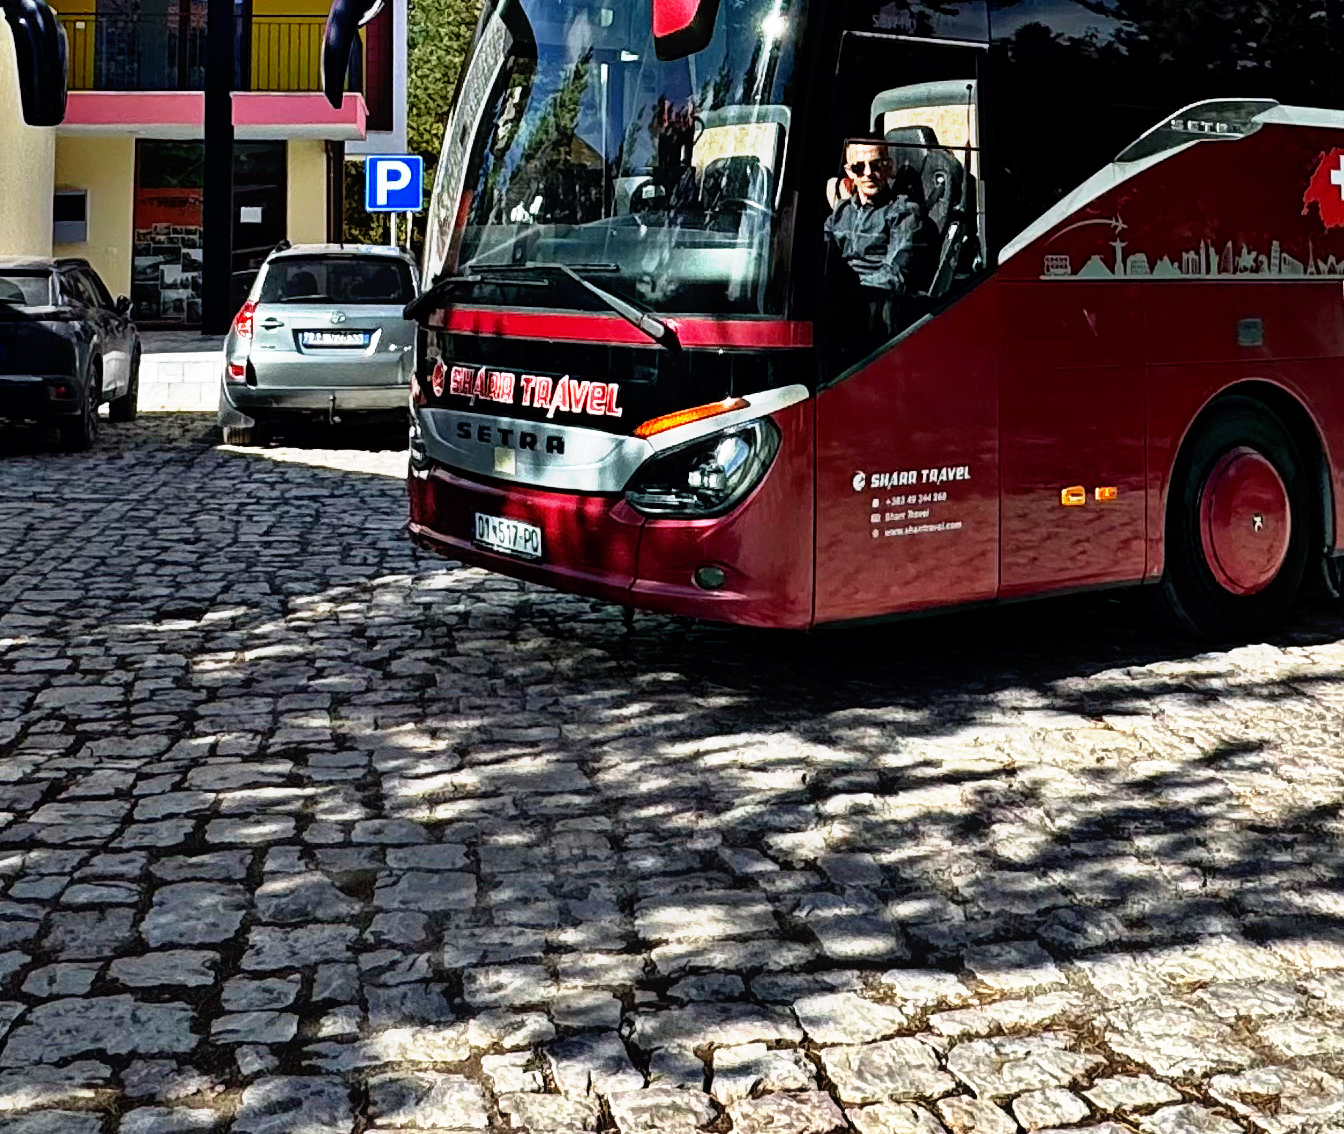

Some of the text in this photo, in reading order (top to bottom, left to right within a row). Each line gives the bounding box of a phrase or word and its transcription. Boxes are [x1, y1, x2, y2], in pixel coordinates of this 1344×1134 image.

[376, 160, 412, 206] P
[449, 365, 516, 407] SHARR
[456, 422, 566, 455] SETRA
[870, 470, 917, 490] SHARR
